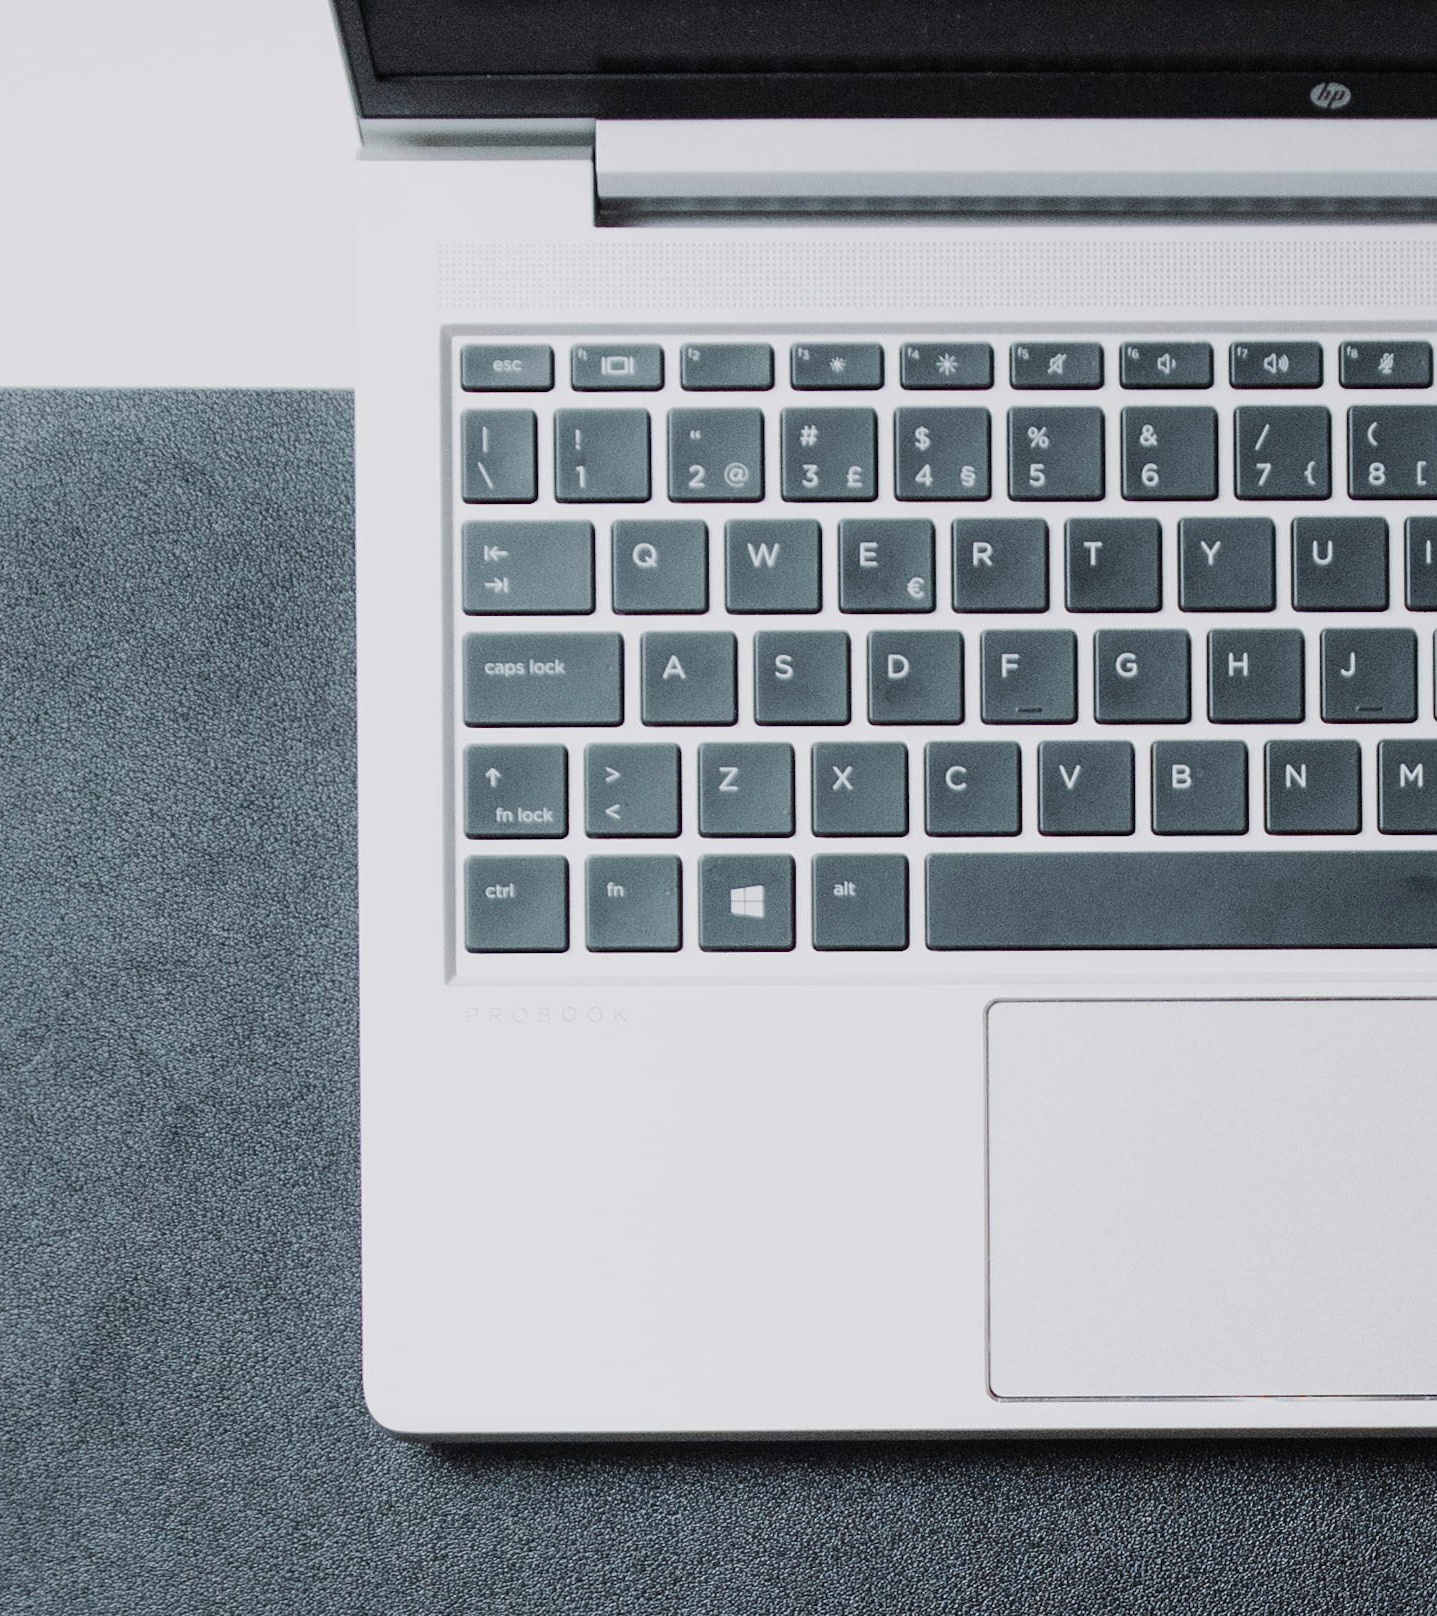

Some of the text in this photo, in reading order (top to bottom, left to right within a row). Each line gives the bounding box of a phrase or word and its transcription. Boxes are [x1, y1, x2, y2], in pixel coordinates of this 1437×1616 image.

[688, 347, 700, 361] f2
[797, 347, 810, 360] f3
[907, 347, 920, 359] f4
[1017, 347, 1029, 359] f5
[1127, 347, 1139, 359] f6
[1236, 346, 1248, 358] f7
[1346, 346, 1358, 359] f8
[493, 359, 522, 373] esc
[574, 429, 582, 450] !
[800, 425, 818, 446] #
[915, 426, 931, 451] $
[1027, 426, 1050, 449] %
[1139, 424, 1158, 447] &
[1254, 423, 1270, 451] /
[1367, 421, 1378, 446] (
[477, 462, 494, 490] \
[575, 465, 586, 488] 1
[688, 464, 705, 489] 2
[724, 463, 749, 487] @
[802, 464, 819, 488] 3
[846, 465, 863, 488] £
[915, 464, 933, 487] 4
[1029, 463, 1046, 487] 5
[1141, 463, 1159, 487] 6
[1256, 462, 1272, 486] 7
[1304, 460, 1316, 486] {
[1368, 462, 1386, 486] 8
[1416, 460, 1427, 486] [
[632, 542, 658, 568] Q
[747, 543, 780, 568] W
[859, 542, 878, 567] E
[972, 541, 993, 566] R
[1083, 541, 1103, 566] T
[1200, 541, 1221, 566] Y
[1312, 540, 1333, 566] U
[907, 577, 925, 599] €
[484, 659, 565, 677] caps lock
[662, 655, 686, 680] A
[775, 654, 794, 680] S
[887, 654, 910, 679] D
[1001, 653, 1020, 678] F
[1115, 652, 1138, 678] G
[1228, 652, 1249, 677] H
[1340, 652, 1356, 678] J
[605, 766, 621, 783] >
[719, 766, 739, 792] Z
[832, 766, 853, 790] X
[945, 765, 967, 791] C
[1059, 764, 1081, 790] V
[1172, 764, 1192, 789] B
[1285, 764, 1307, 788] N
[1399, 763, 1424, 788] M
[495, 807, 553, 823] fn lock
[605, 804, 621, 820] <
[485, 883, 515, 899] ctrl
[606, 882, 625, 897] fn
[833, 881, 856, 896] alt
[465, 1004, 628, 1025] PROBOOK
